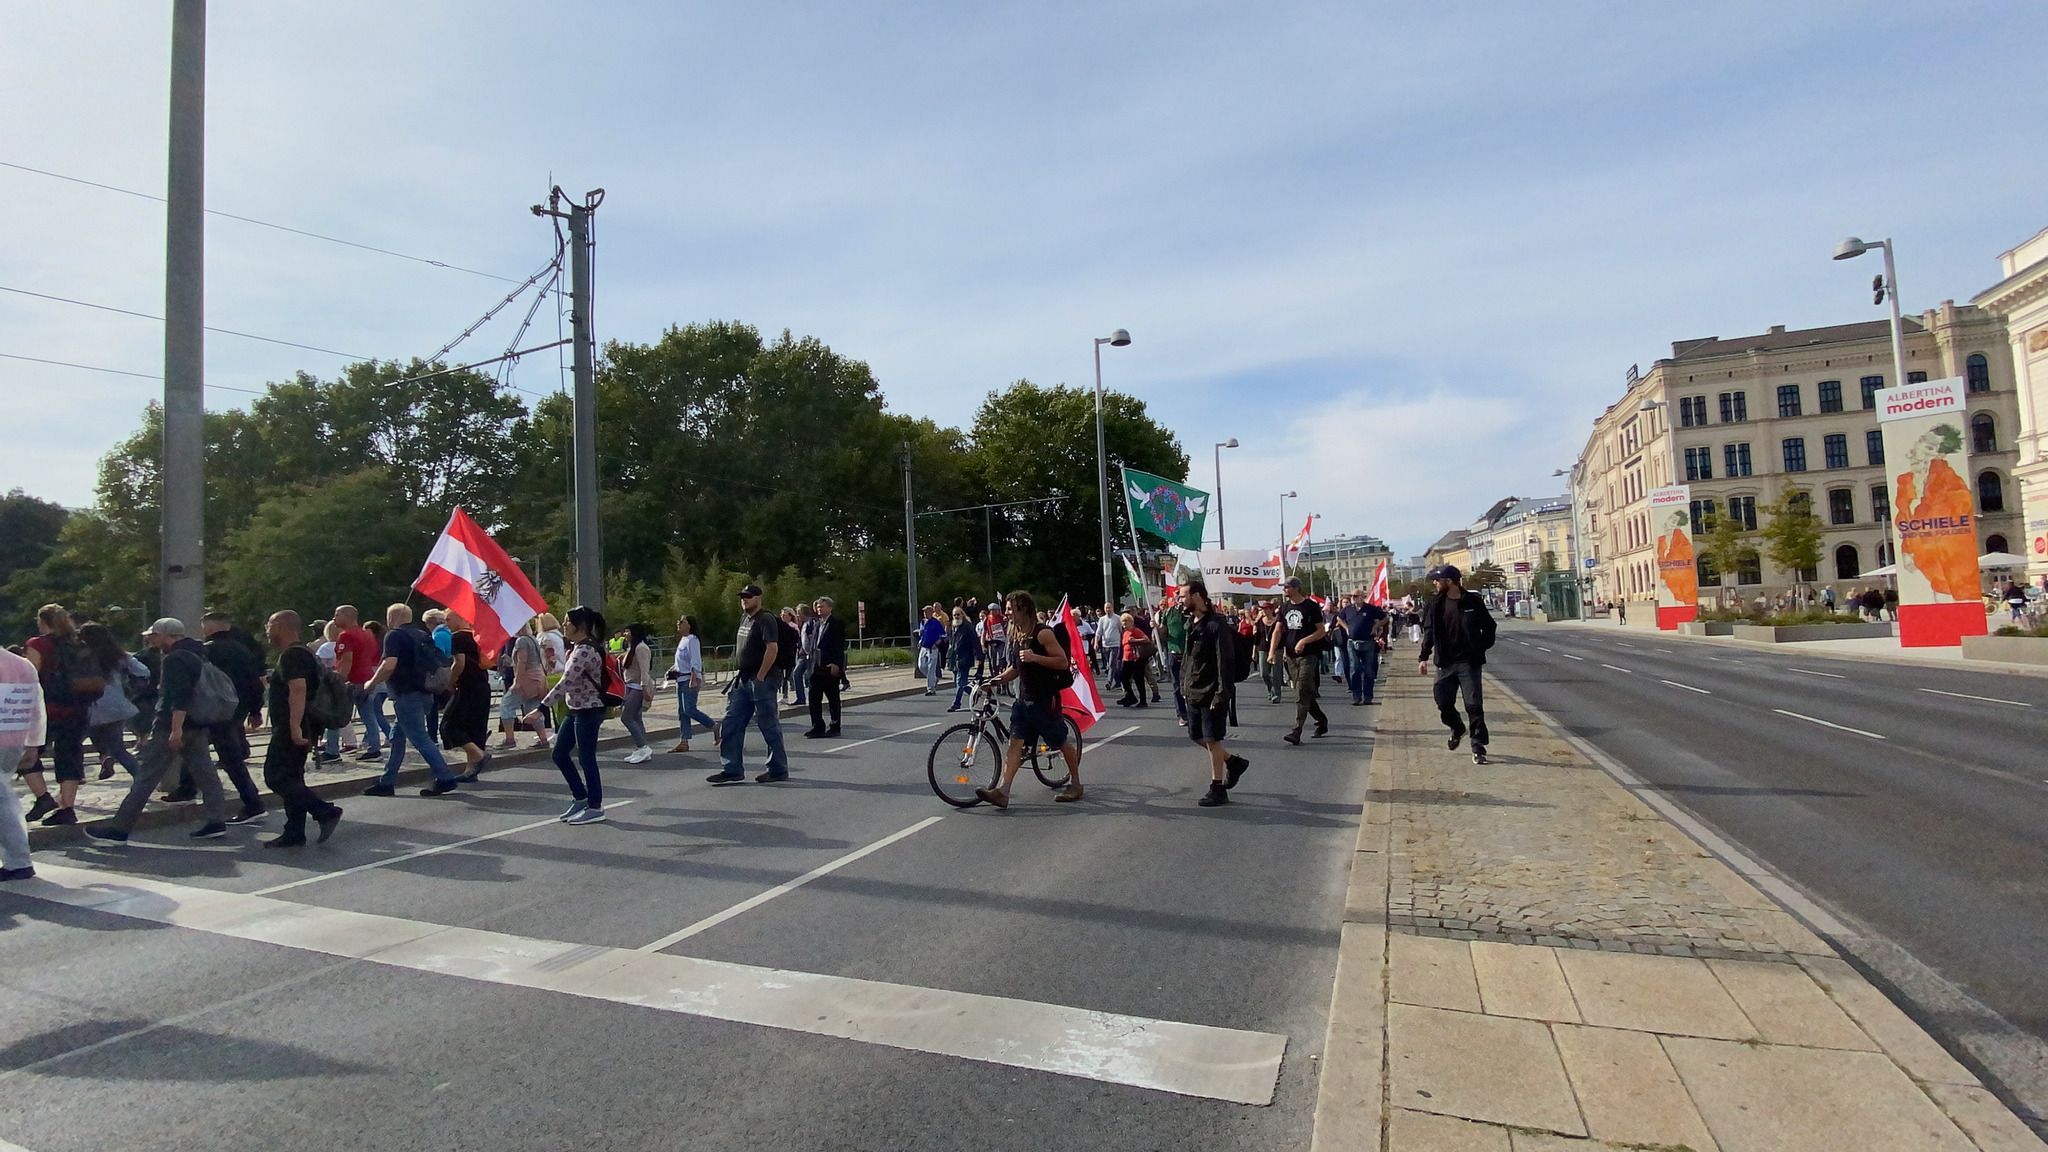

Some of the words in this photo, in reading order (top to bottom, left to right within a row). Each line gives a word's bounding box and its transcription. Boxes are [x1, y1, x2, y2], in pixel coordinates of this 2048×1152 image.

[1887, 386, 1952, 402] ALBERTINA
[1887, 396, 1954, 414] modern
[1653, 495, 1685, 503] modern
[1899, 516, 1969, 531] SCHIELE
[1224, 566, 1259, 575] MUSS
